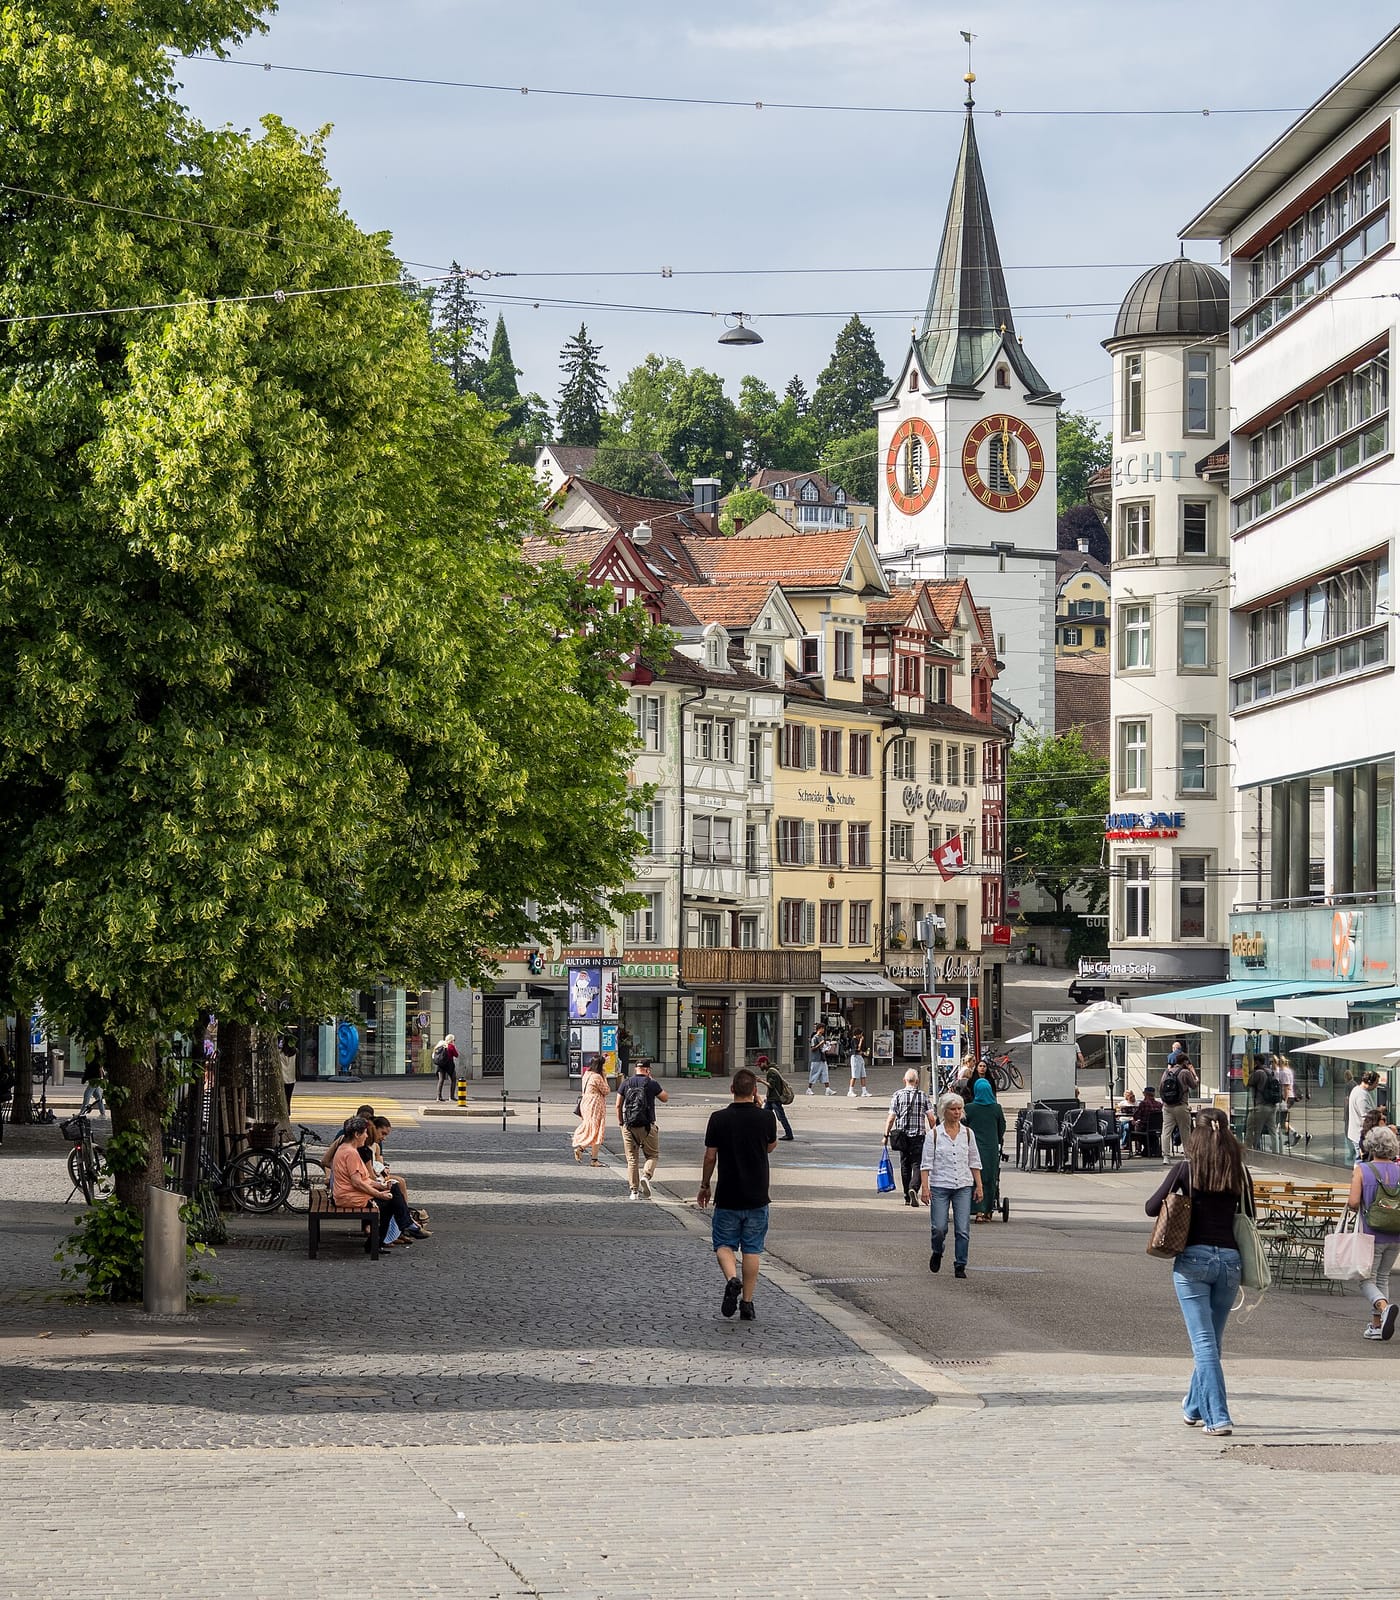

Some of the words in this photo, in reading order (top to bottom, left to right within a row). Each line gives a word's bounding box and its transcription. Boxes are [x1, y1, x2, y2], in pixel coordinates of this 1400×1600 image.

[798, 788, 825, 803] Schneider
[836, 792, 856, 805] Schuhe
[619, 965, 673, 978] ROGERIE
